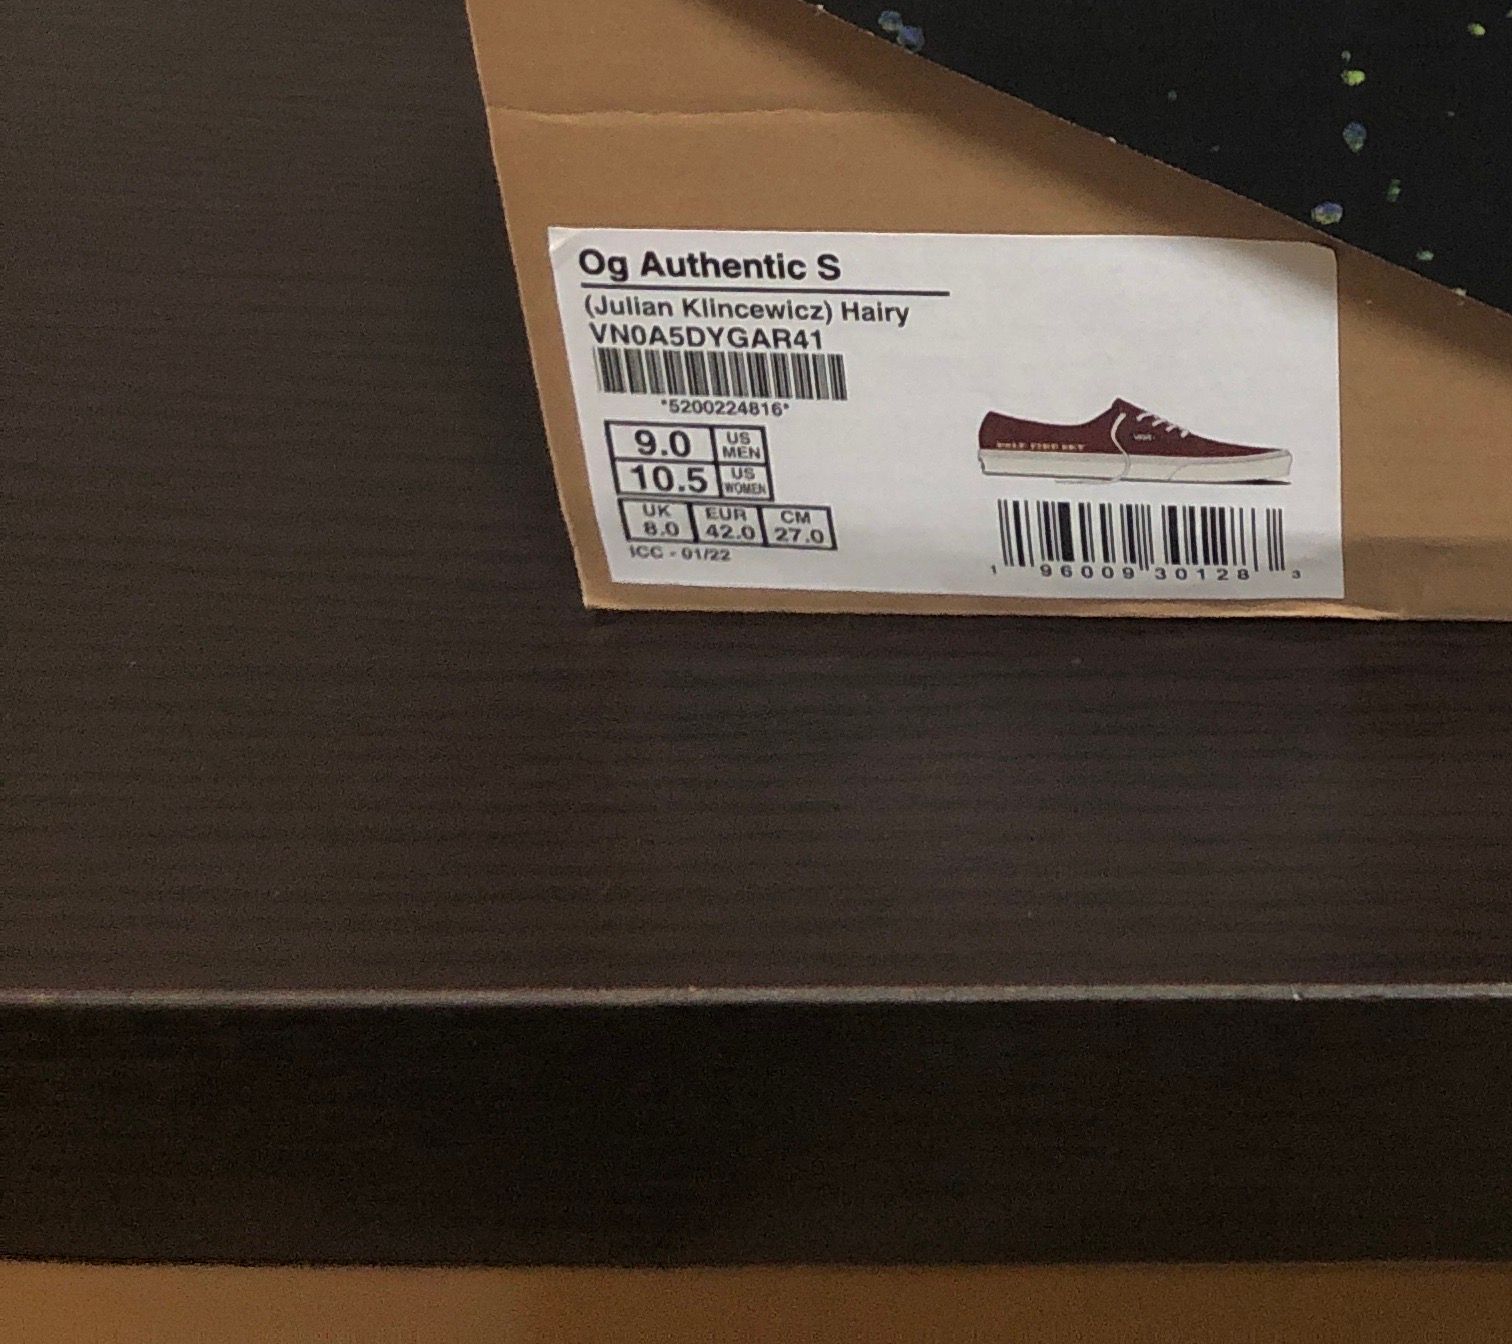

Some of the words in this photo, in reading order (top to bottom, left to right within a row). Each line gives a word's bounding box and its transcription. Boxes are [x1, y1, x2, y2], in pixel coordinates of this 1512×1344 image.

[578, 248, 629, 282] Og
[640, 250, 807, 280] Authentic
[817, 254, 842, 281] S
[584, 294, 673, 318] (Julian
[682, 297, 833, 325] Klincewicz)
[841, 301, 909, 327] Hairy
[589, 322, 822, 350] VN0A5DYGAR41
[634, 429, 691, 458] 9.0
[726, 431, 751, 444] US
[722, 446, 761, 460] MEN
[630, 464, 708, 493] 10.5
[731, 467, 755, 480] US
[724, 482, 766, 496] WOMEN
[642, 504, 671, 517] UK
[706, 507, 747, 521] EUR
[780, 510, 811, 524] CM
[643, 522, 680, 537] 8.0
[705, 525, 756, 540] 42.0
[774, 528, 824, 544] 27.0
[681, 548, 731, 561] 01/22
